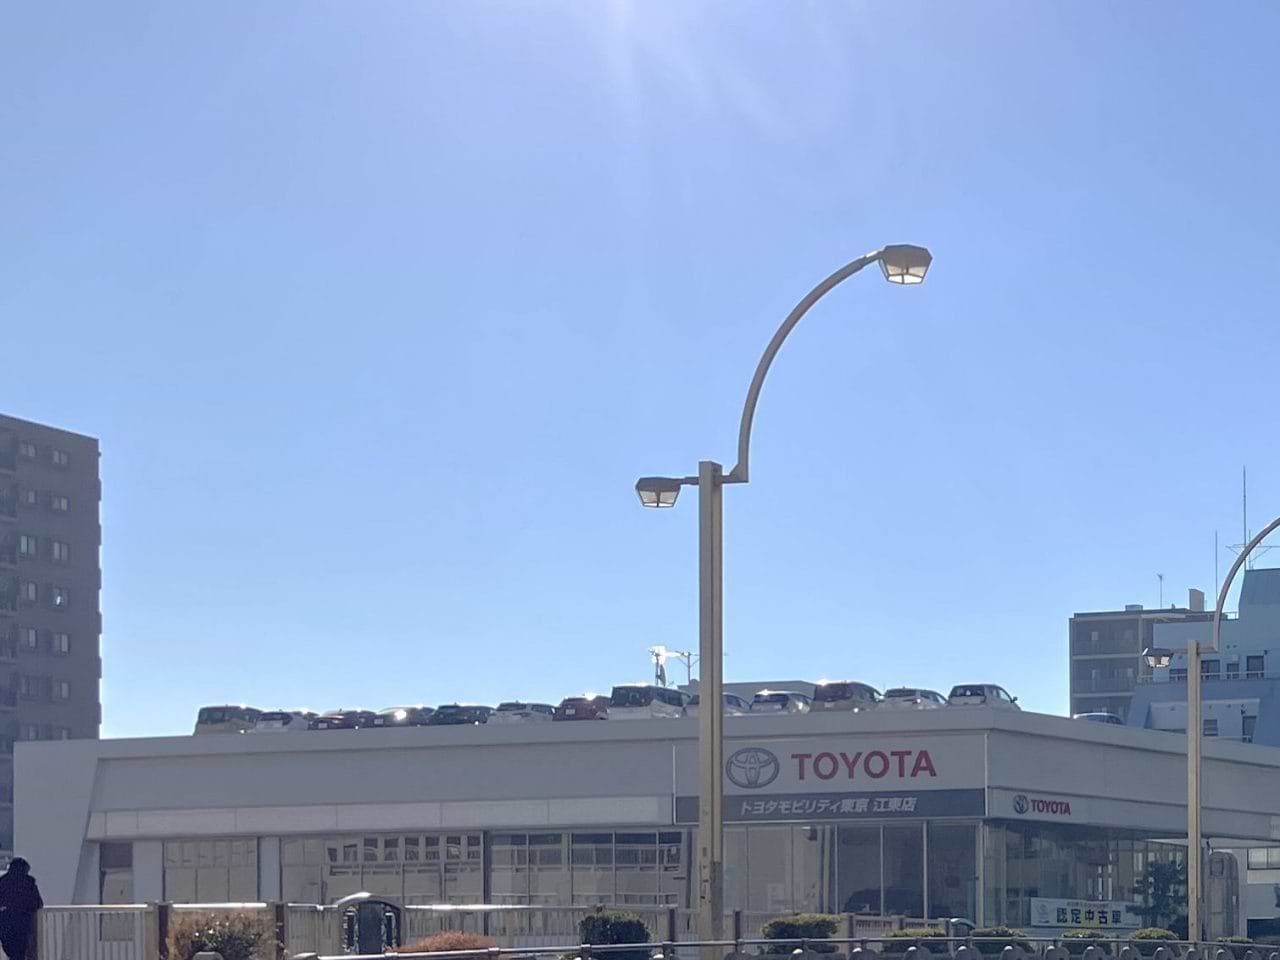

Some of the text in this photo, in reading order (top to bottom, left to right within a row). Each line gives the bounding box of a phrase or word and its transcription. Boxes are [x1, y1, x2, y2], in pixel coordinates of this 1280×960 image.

[791, 749, 937, 781] TOYOTA
[741, 796, 918, 816] トヨタモビリティ東京 江東店
[1030, 798, 1071, 817] TOYOTA
[1056, 906, 1122, 925] 認定中古車
